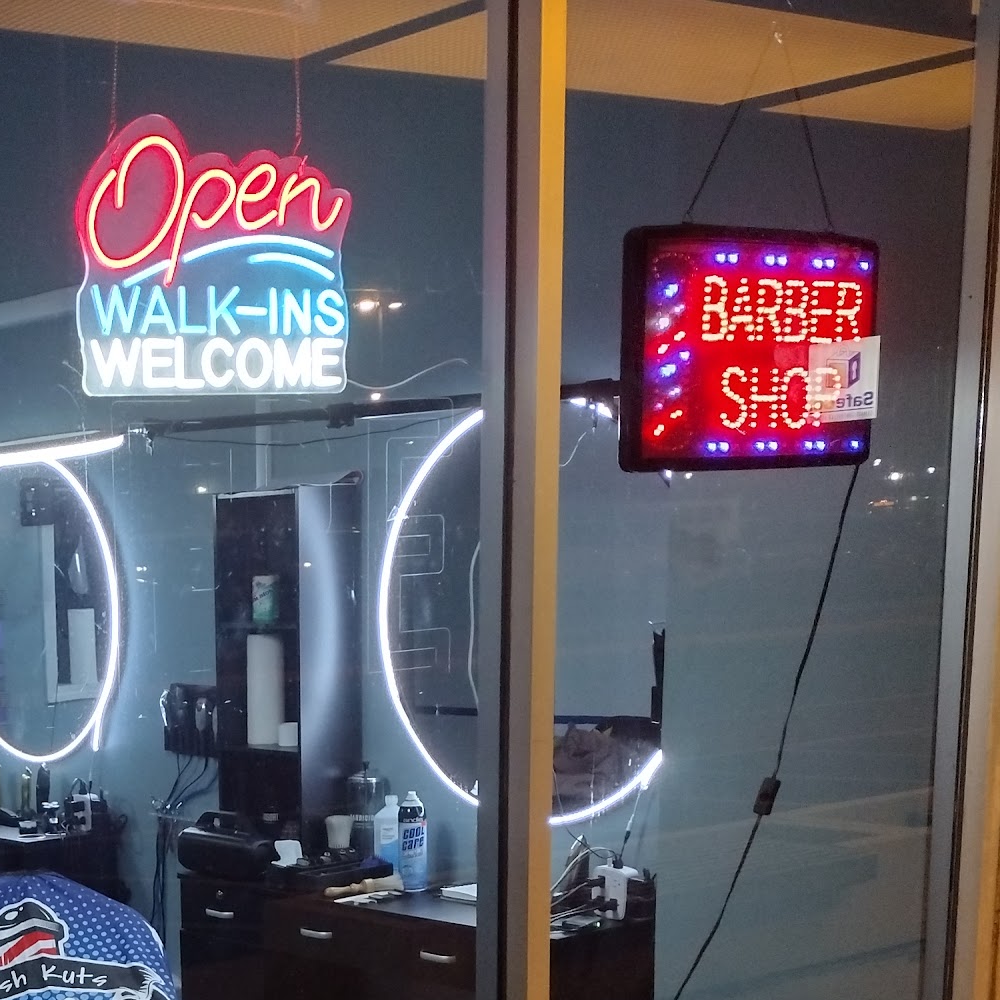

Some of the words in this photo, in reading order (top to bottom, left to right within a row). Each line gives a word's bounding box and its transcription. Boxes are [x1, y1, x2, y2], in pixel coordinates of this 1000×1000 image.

[88, 135, 344, 287] Open
[90, 285, 345, 336] WALK-INS
[701, 274, 863, 344] BARBER
[90, 335, 344, 389] WELCOME
[719, 366, 841, 429] SHOP
[40, 963, 108, 987] Kuts
